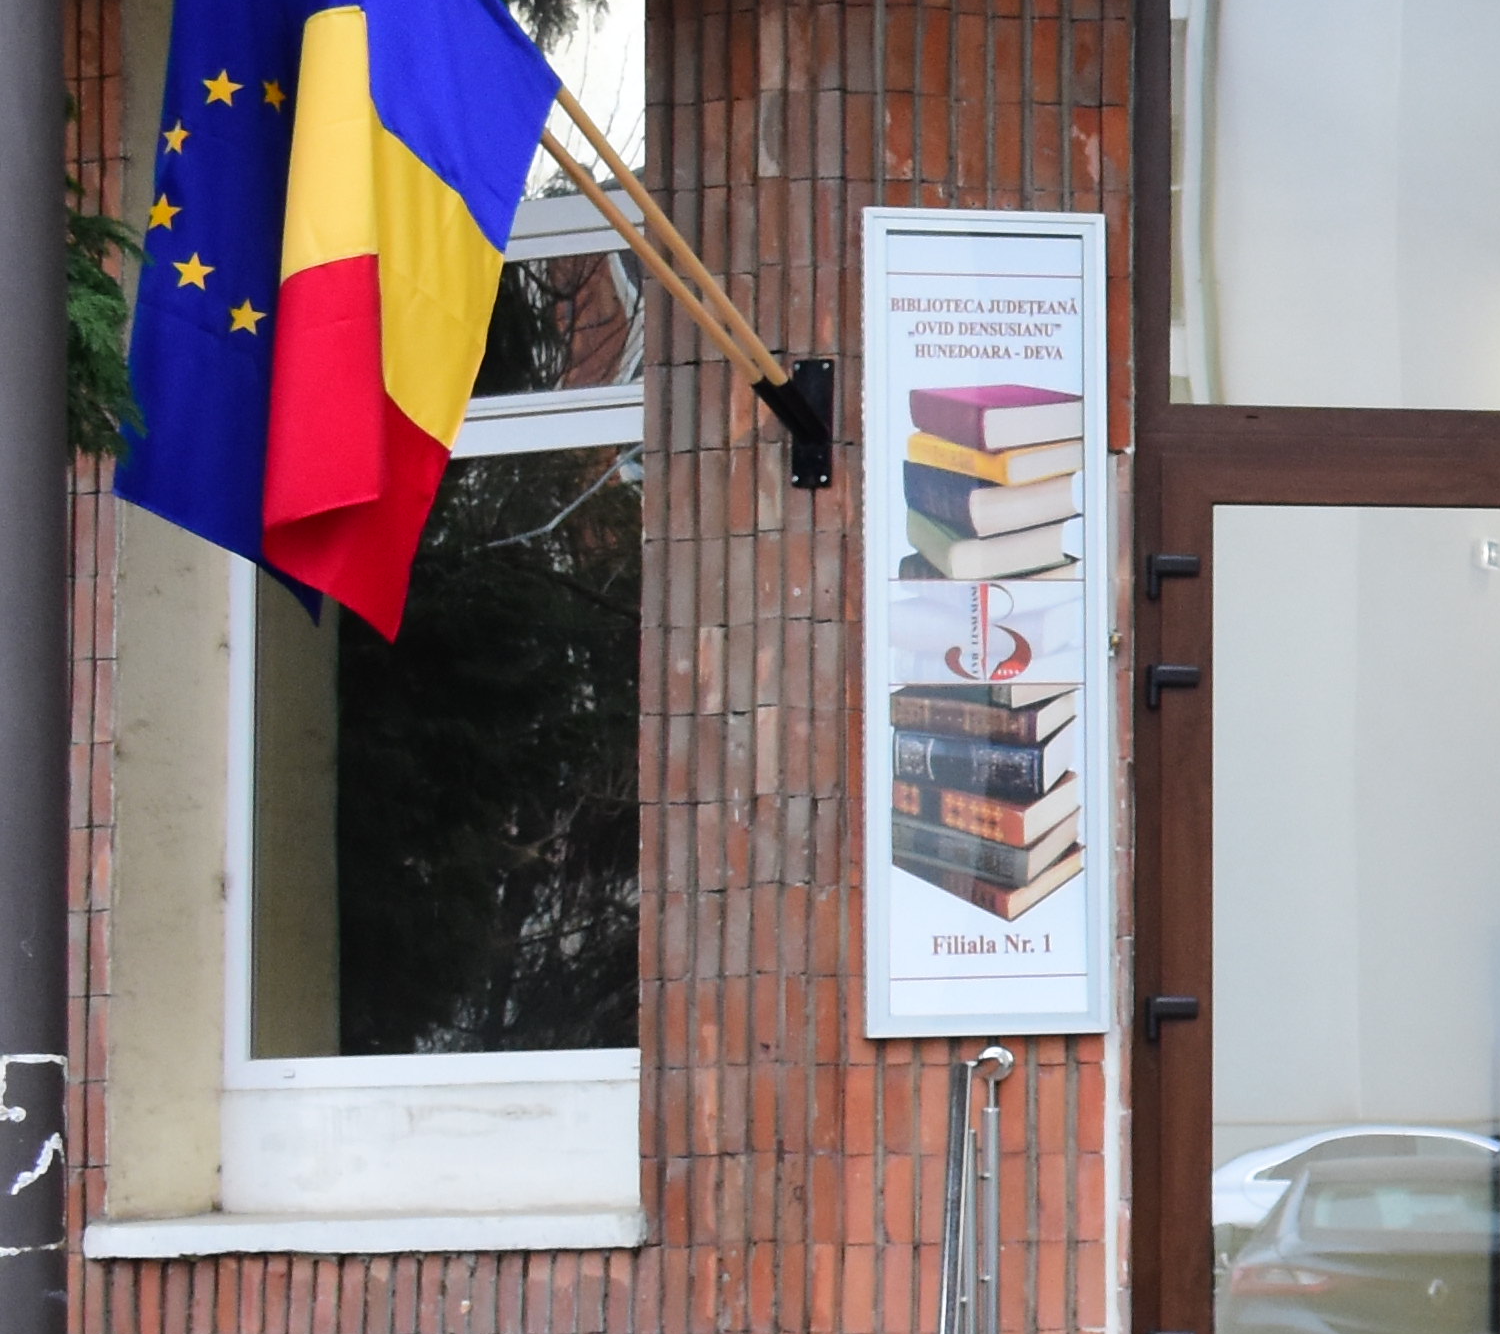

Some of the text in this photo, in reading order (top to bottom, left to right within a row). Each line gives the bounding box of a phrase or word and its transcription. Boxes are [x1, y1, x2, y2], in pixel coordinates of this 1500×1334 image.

[890, 297, 1078, 317] BIBLIOTECA JUDEȚEANĂ
[915, 344, 1011, 359] HUNEDOARA
[1024, 345, 1063, 360] DEVA
[931, 933, 1052, 955] Filiala Nr. 1
